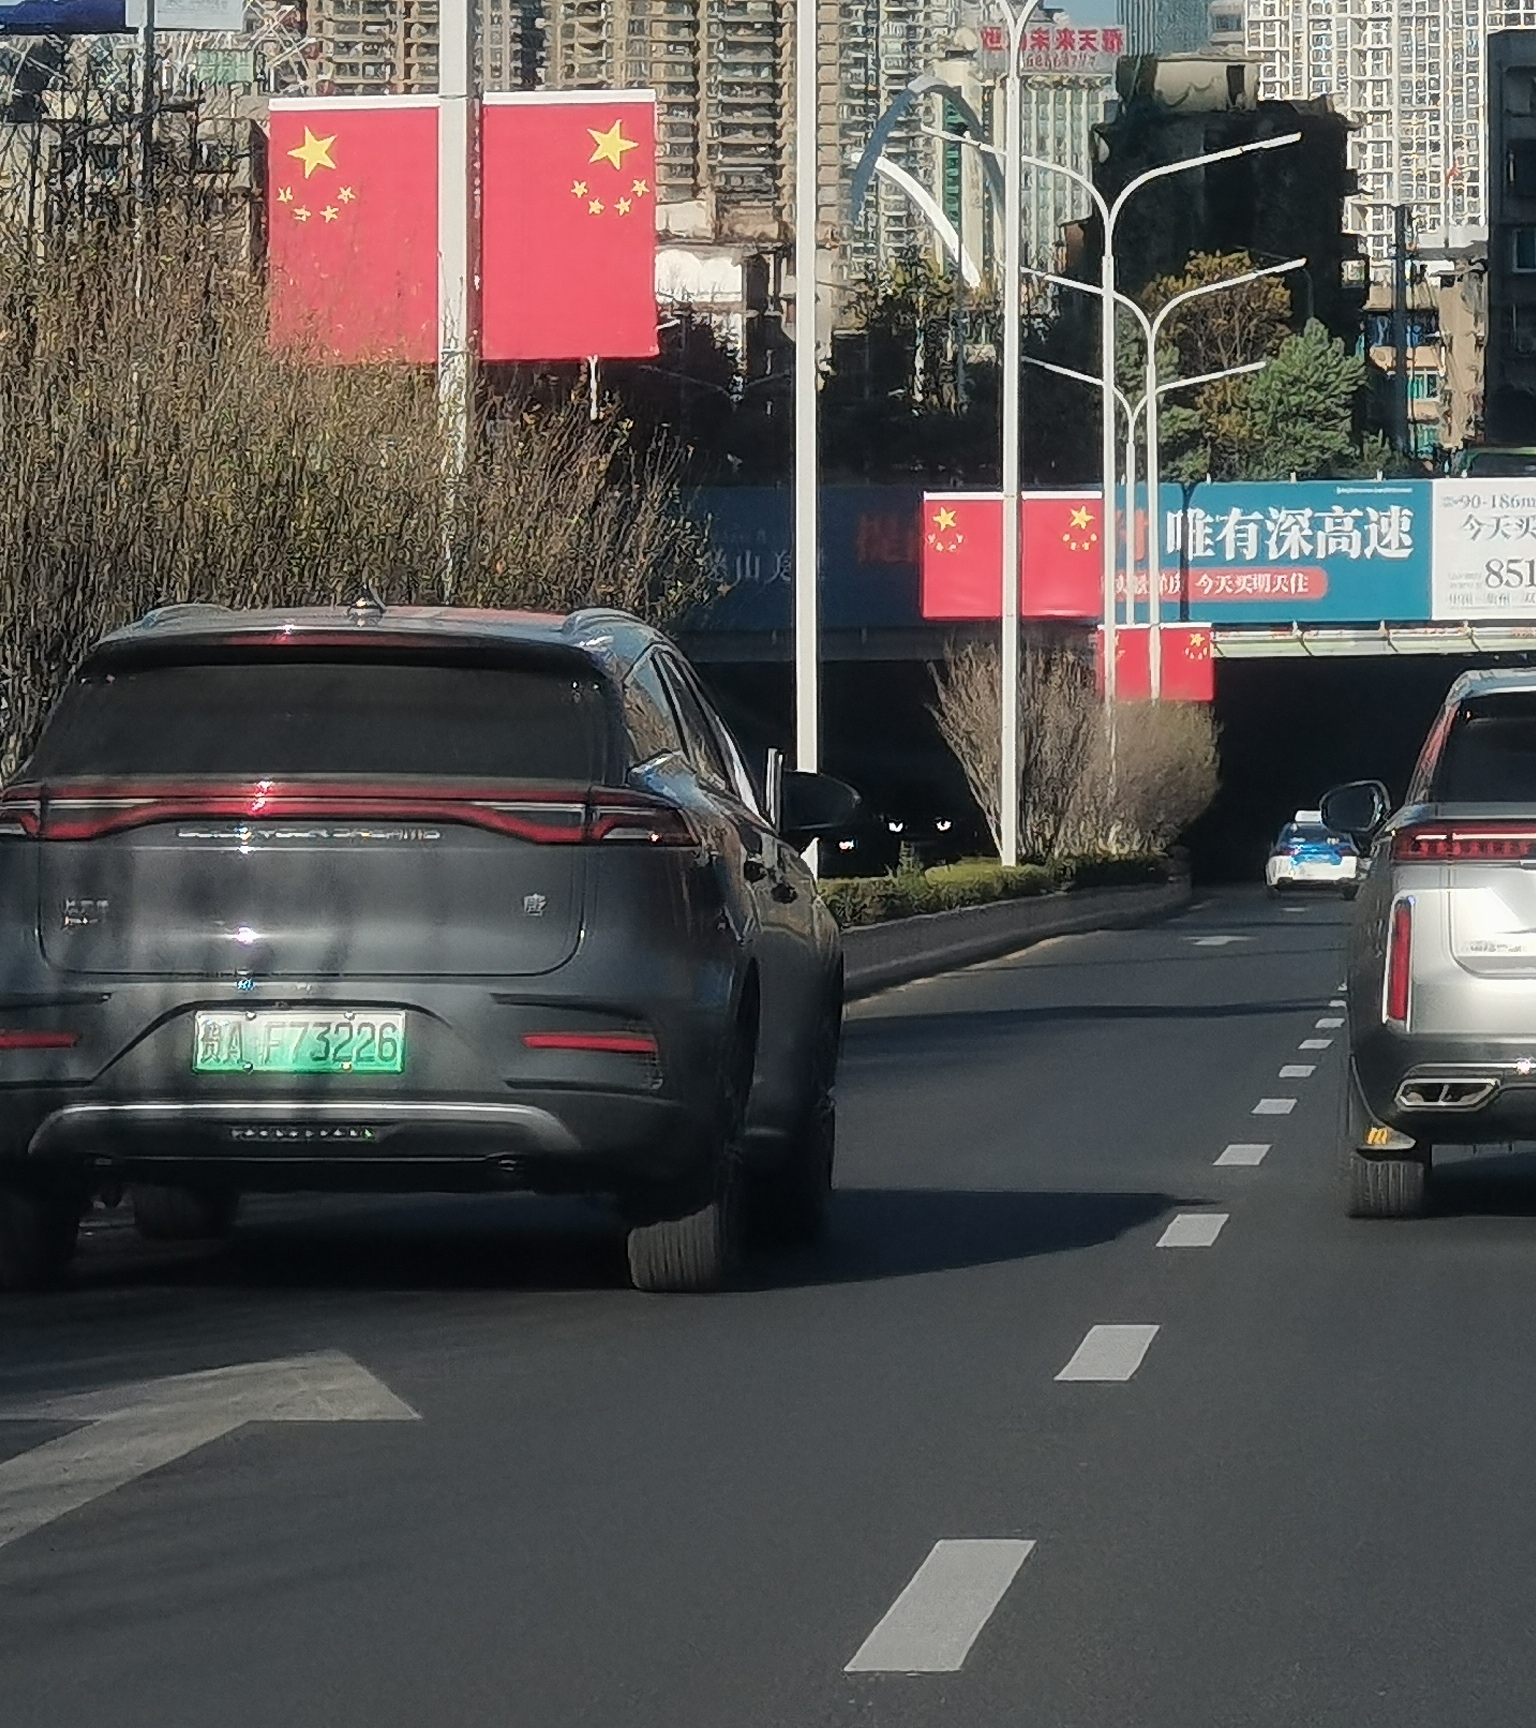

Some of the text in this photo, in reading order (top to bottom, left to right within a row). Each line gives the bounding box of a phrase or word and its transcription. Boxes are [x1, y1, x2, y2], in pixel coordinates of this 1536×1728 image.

[1166, 504, 1415, 562] 唯有深高速
[1195, 572, 1309, 595] 今天买明天住
